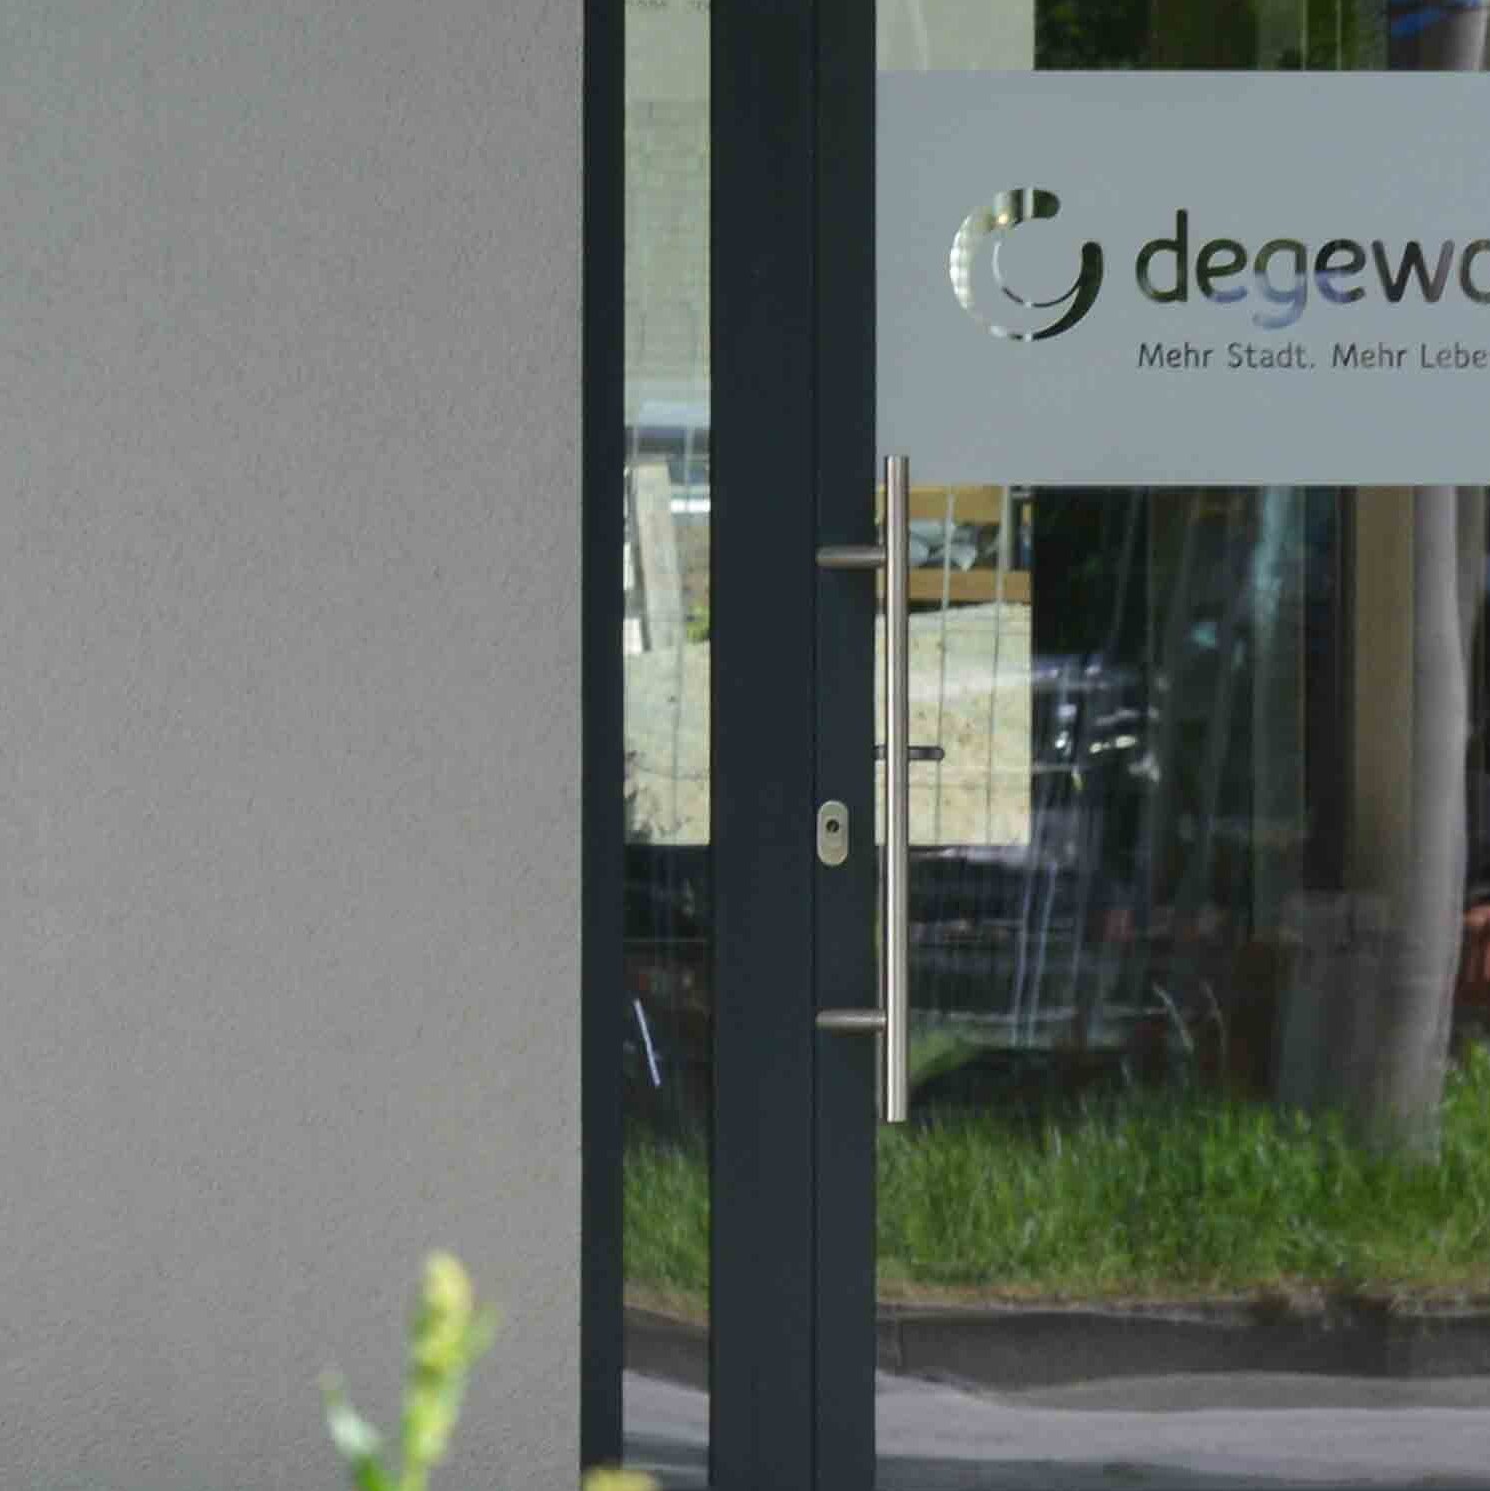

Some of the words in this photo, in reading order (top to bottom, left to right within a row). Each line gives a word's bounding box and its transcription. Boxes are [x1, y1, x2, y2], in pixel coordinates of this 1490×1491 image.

[1137, 341, 1215, 369] Mehr
[1226, 341, 1317, 370] Stadt.
[1331, 341, 1408, 369] Mehr
